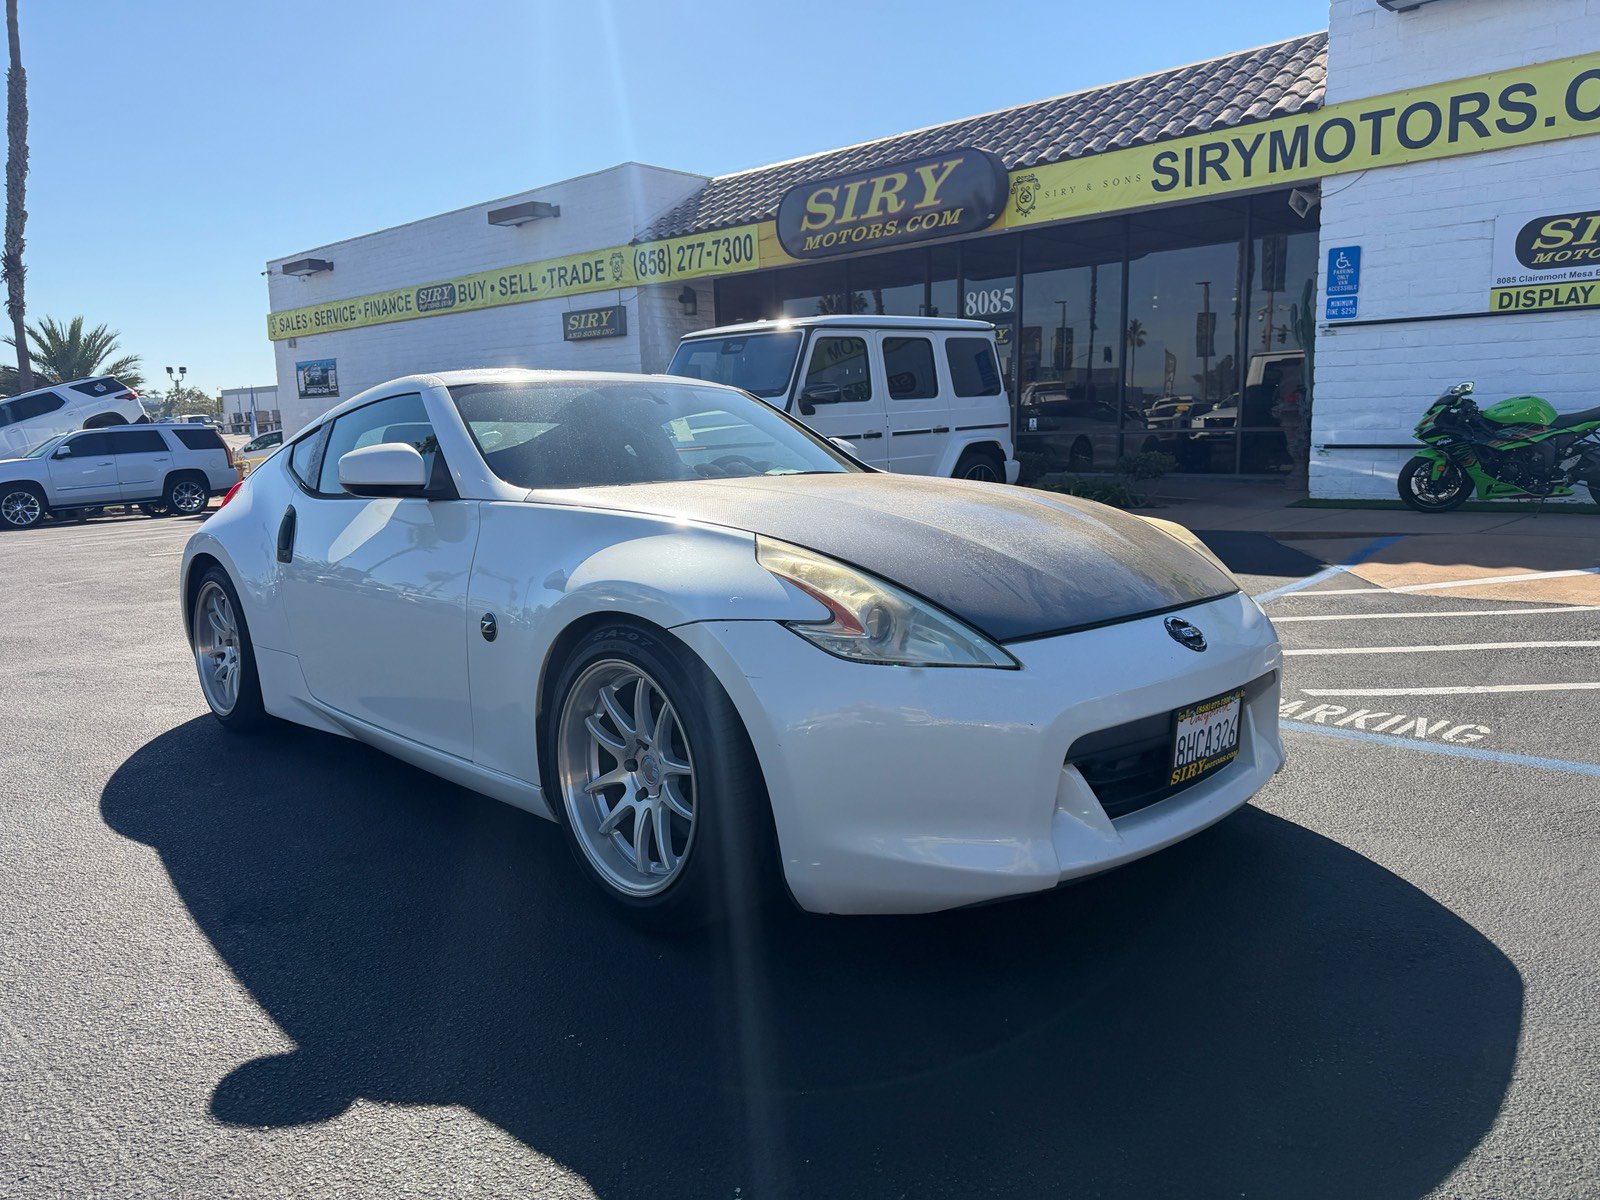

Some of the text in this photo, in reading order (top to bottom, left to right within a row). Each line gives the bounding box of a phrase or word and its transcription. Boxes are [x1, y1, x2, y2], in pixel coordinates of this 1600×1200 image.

[801, 158, 964, 232] SIRY
[1044, 173, 1142, 199] SIRY & SONS
[802, 208, 963, 251] MOTORS.COM
[633, 234, 753, 281] (858) 277-7300
[458, 259, 605, 303] BUY SELL TRADE
[1496, 277, 1517, 285] 8085
[1518, 272, 1567, 283] Clairemont
[1569, 270, 1593, 279] Mesa
[420, 285, 453, 304] SIRY
[965, 288, 1015, 316] 8085
[1498, 285, 1596, 310] DISPLAY
[280, 294, 412, 333] SALES SERVICE FINANCE
[567, 310, 613, 331] SIRY
[567, 327, 616, 340] AND SONS INC
[1279, 698, 1491, 743] ARKING
[1176, 714, 1238, 767] 8HCA326
[1170, 757, 1208, 786] SIRY
